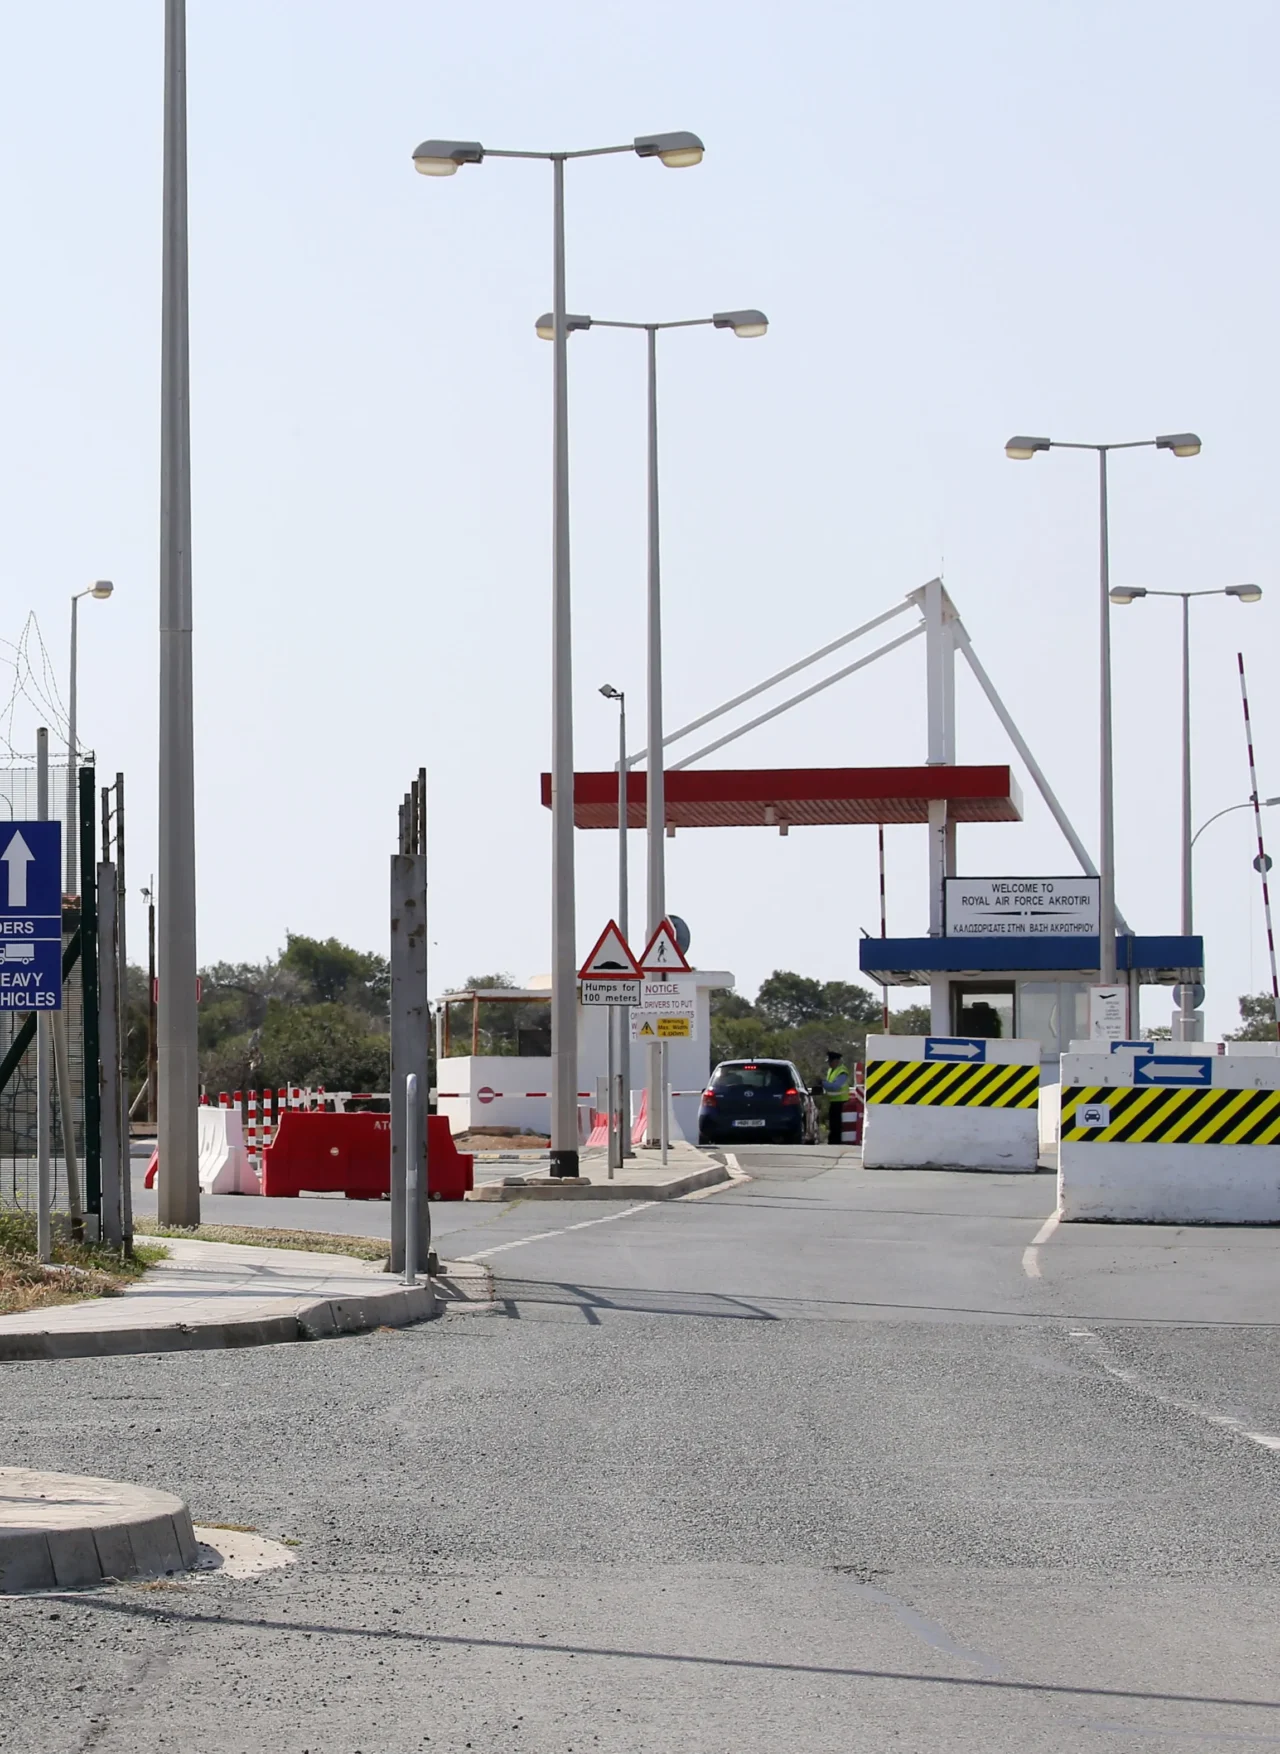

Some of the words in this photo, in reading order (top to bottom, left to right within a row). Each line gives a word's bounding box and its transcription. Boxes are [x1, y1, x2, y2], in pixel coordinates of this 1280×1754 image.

[992, 883, 1038, 893] WELCOME
[1041, 883, 1054, 893] TO
[962, 896, 990, 906] ROYAL
[995, 896, 1010, 906] AIR
[1014, 896, 1044, 906] FORCE
[1048, 896, 1091, 906] AKROTIRI
[1007, 923, 1026, 933] ΣΤΗΝ
[1029, 923, 1049, 933] ΒΑΣΗ
[585, 983, 618, 992] Humps
[622, 983, 636, 992] for
[645, 984, 679, 993] NOTICE
[584, 994, 600, 1002] 100
[605, 994, 637, 1002] meters
[644, 1000, 670, 1009] DRIVERS
[672, 1000, 680, 1009] TO
[681, 1000, 693, 1009] PUT
